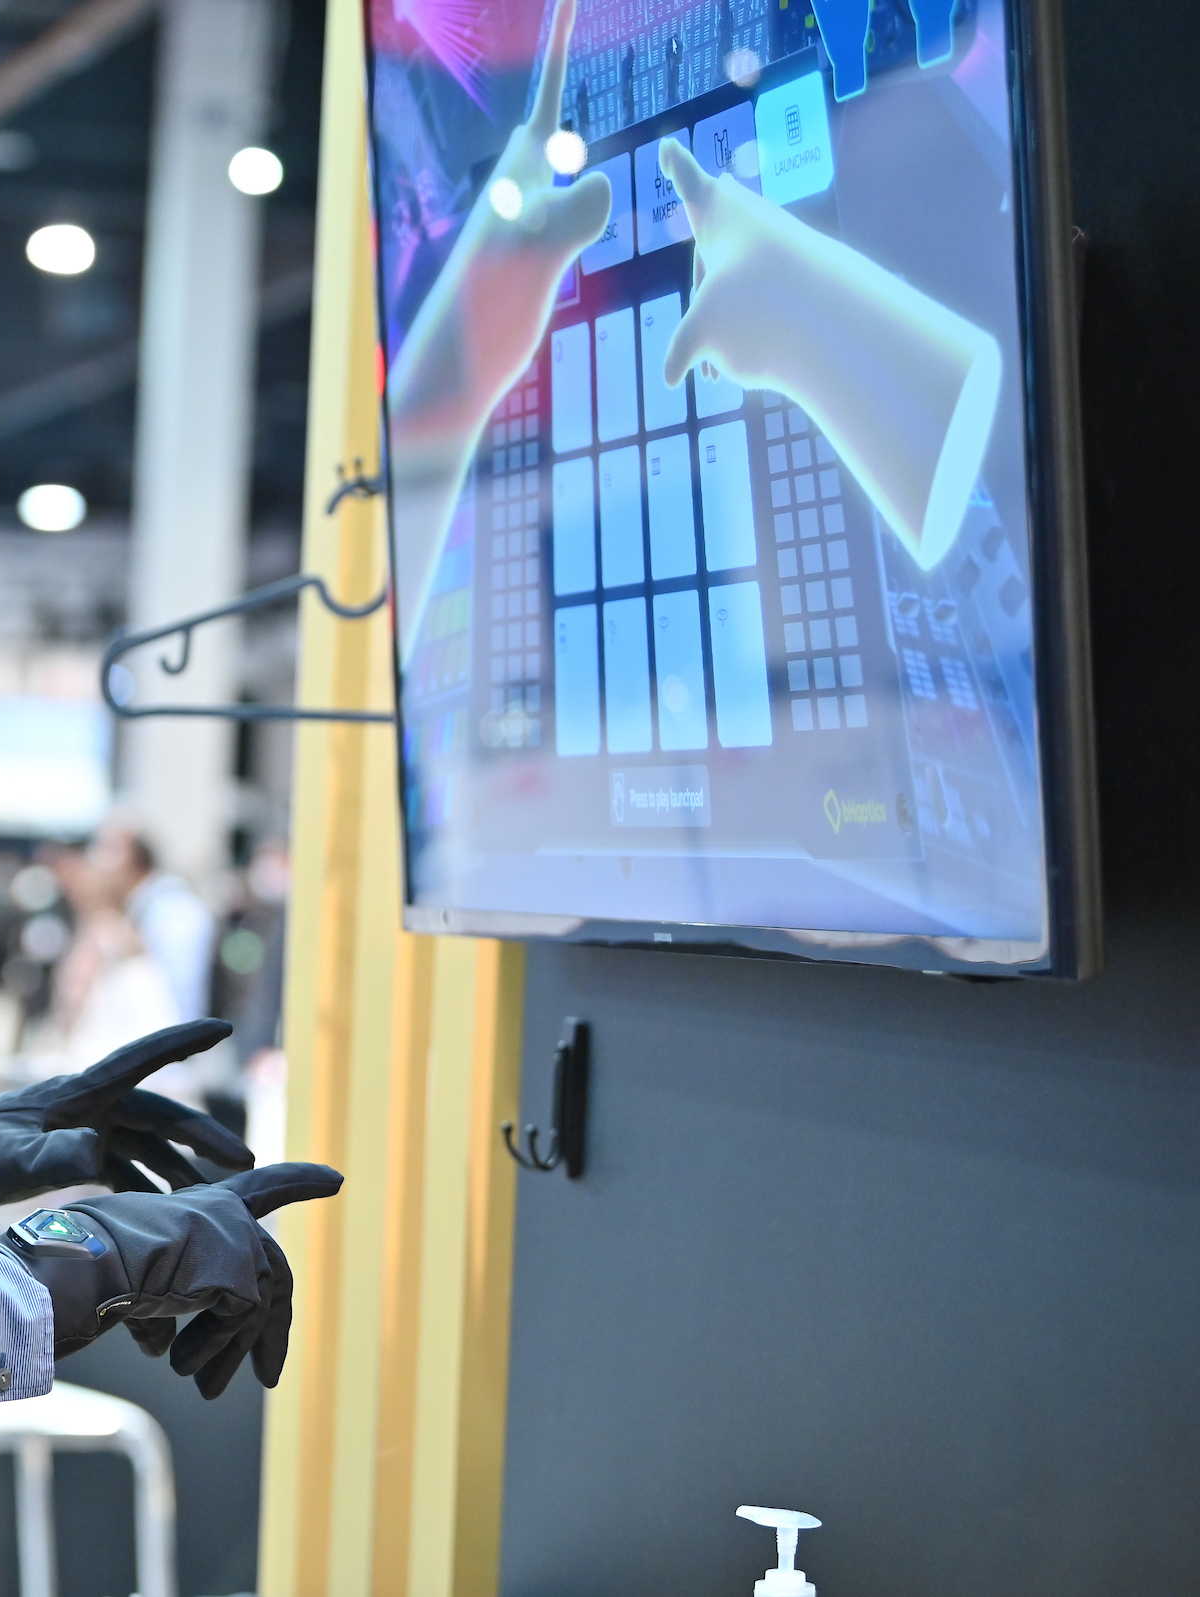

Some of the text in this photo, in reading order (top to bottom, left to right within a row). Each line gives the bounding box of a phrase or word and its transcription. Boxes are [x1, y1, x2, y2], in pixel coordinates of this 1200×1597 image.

[774, 146, 821, 176] LAUNCHPAD
[652, 200, 678, 223] MIXER
[629, 788, 648, 808] Press
[656, 787, 669, 812] play
[669, 787, 704, 812] launchpad
